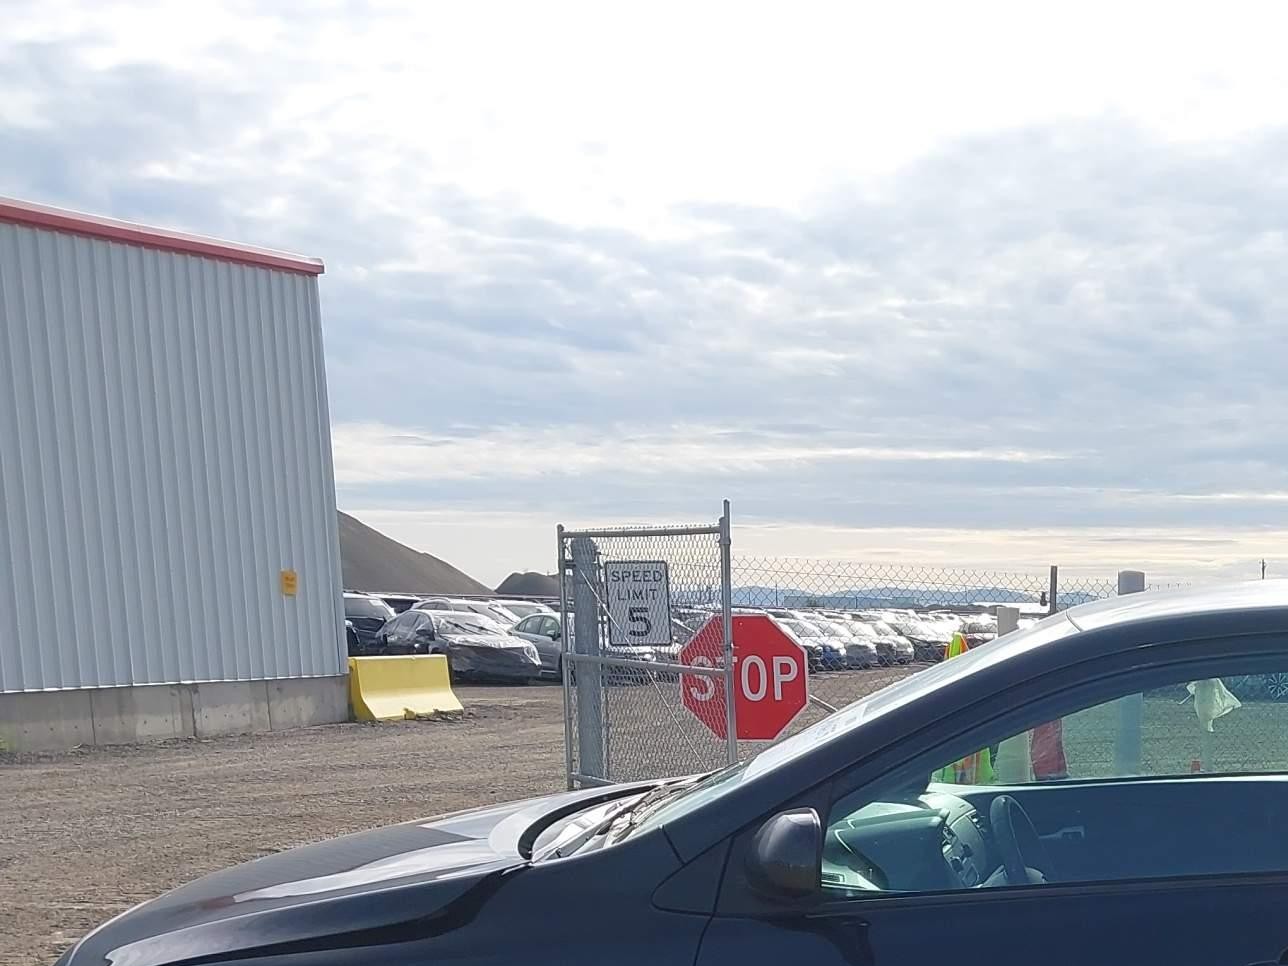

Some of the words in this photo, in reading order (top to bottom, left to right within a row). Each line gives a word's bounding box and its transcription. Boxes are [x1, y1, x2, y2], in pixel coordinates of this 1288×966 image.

[611, 571, 662, 582] SPEED
[617, 588, 657, 601] LIMIT
[629, 607, 651, 636] 5
